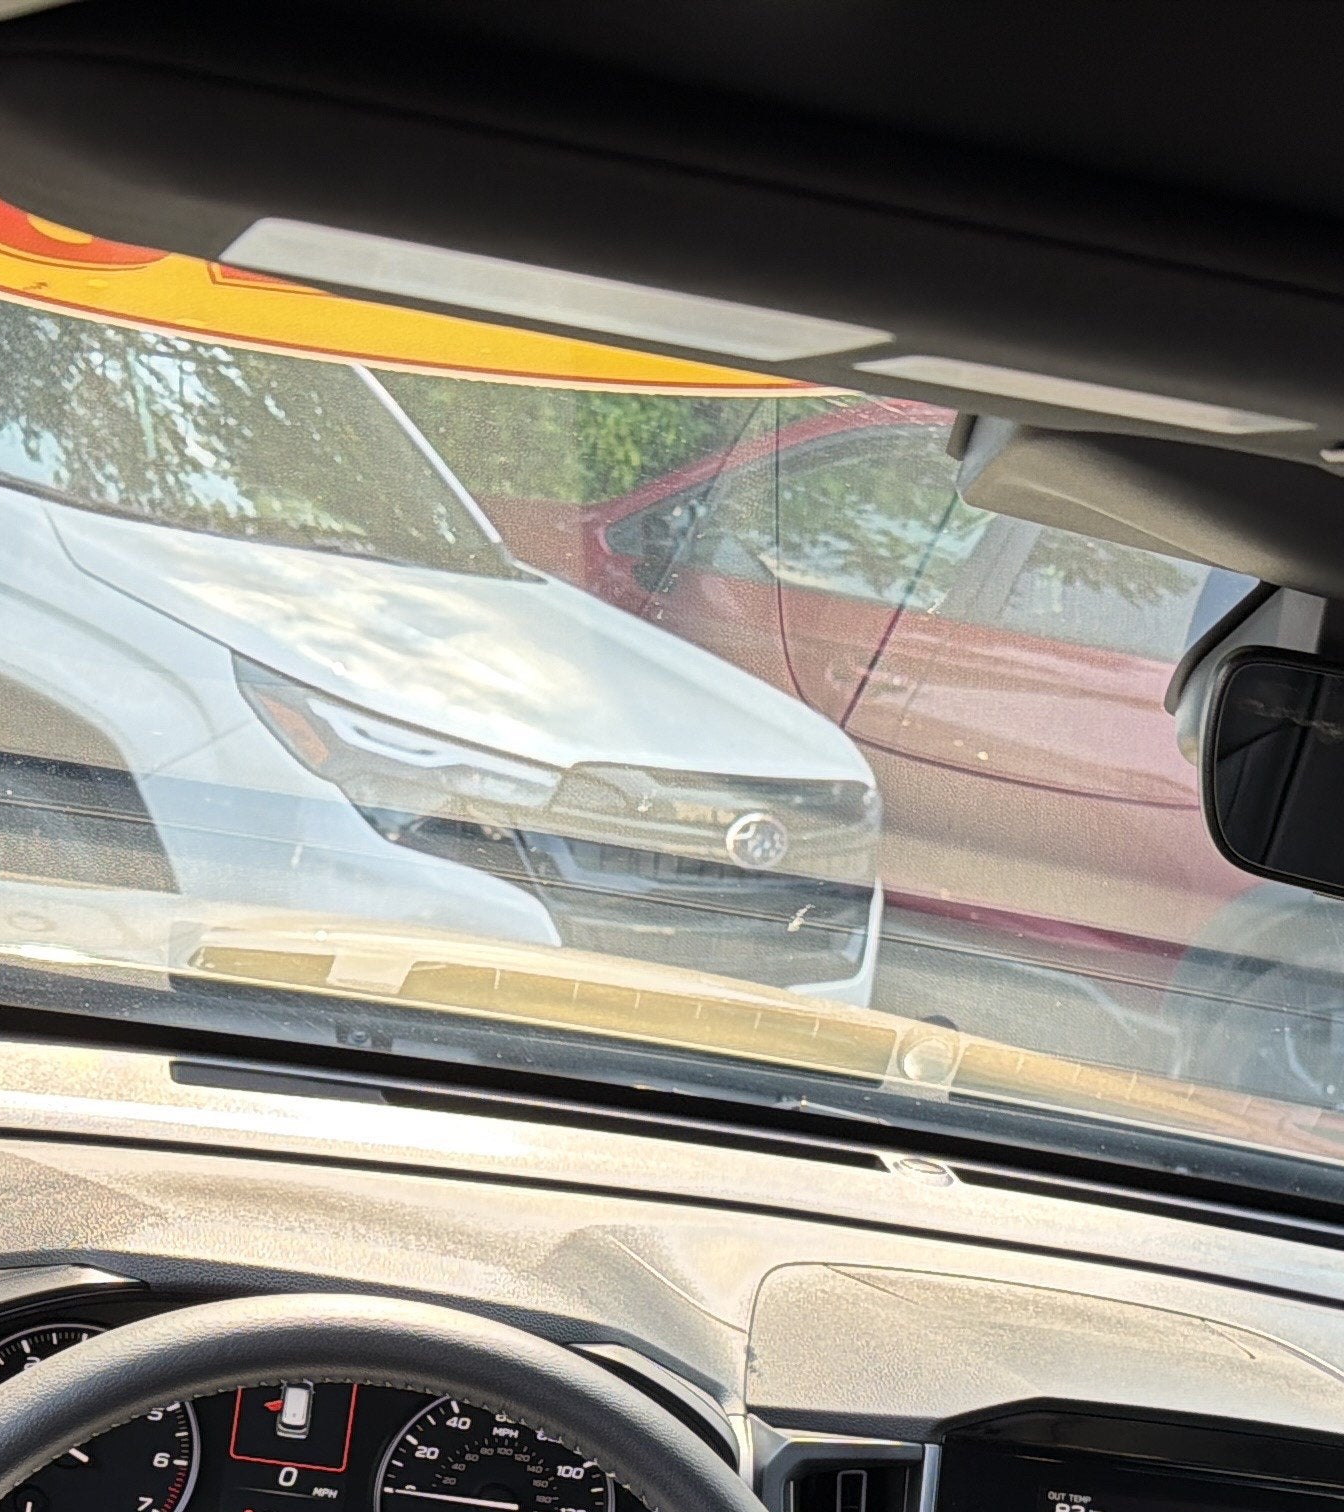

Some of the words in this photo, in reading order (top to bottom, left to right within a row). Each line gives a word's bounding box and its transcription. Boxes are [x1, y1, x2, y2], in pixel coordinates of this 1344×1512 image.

[446, 1417, 471, 1430] 40
[492, 1427, 518, 1438] MPH
[415, 1447, 439, 1460] 20
[497, 1448, 513, 1456] 100
[515, 1454, 530, 1462] 120
[153, 1452, 170, 1468] 6
[451, 1464, 466, 1472] 40
[527, 1465, 543, 1474] 140
[557, 1466, 584, 1480] 100
[279, 1467, 298, 1486] 0
[312, 1487, 338, 1498] MPH
[442, 1477, 456, 1485] 20
[1048, 1491, 1066, 1501] OUT
[1069, 1493, 1091, 1503] TEMP
[138, 1497, 154, 1511] 7
